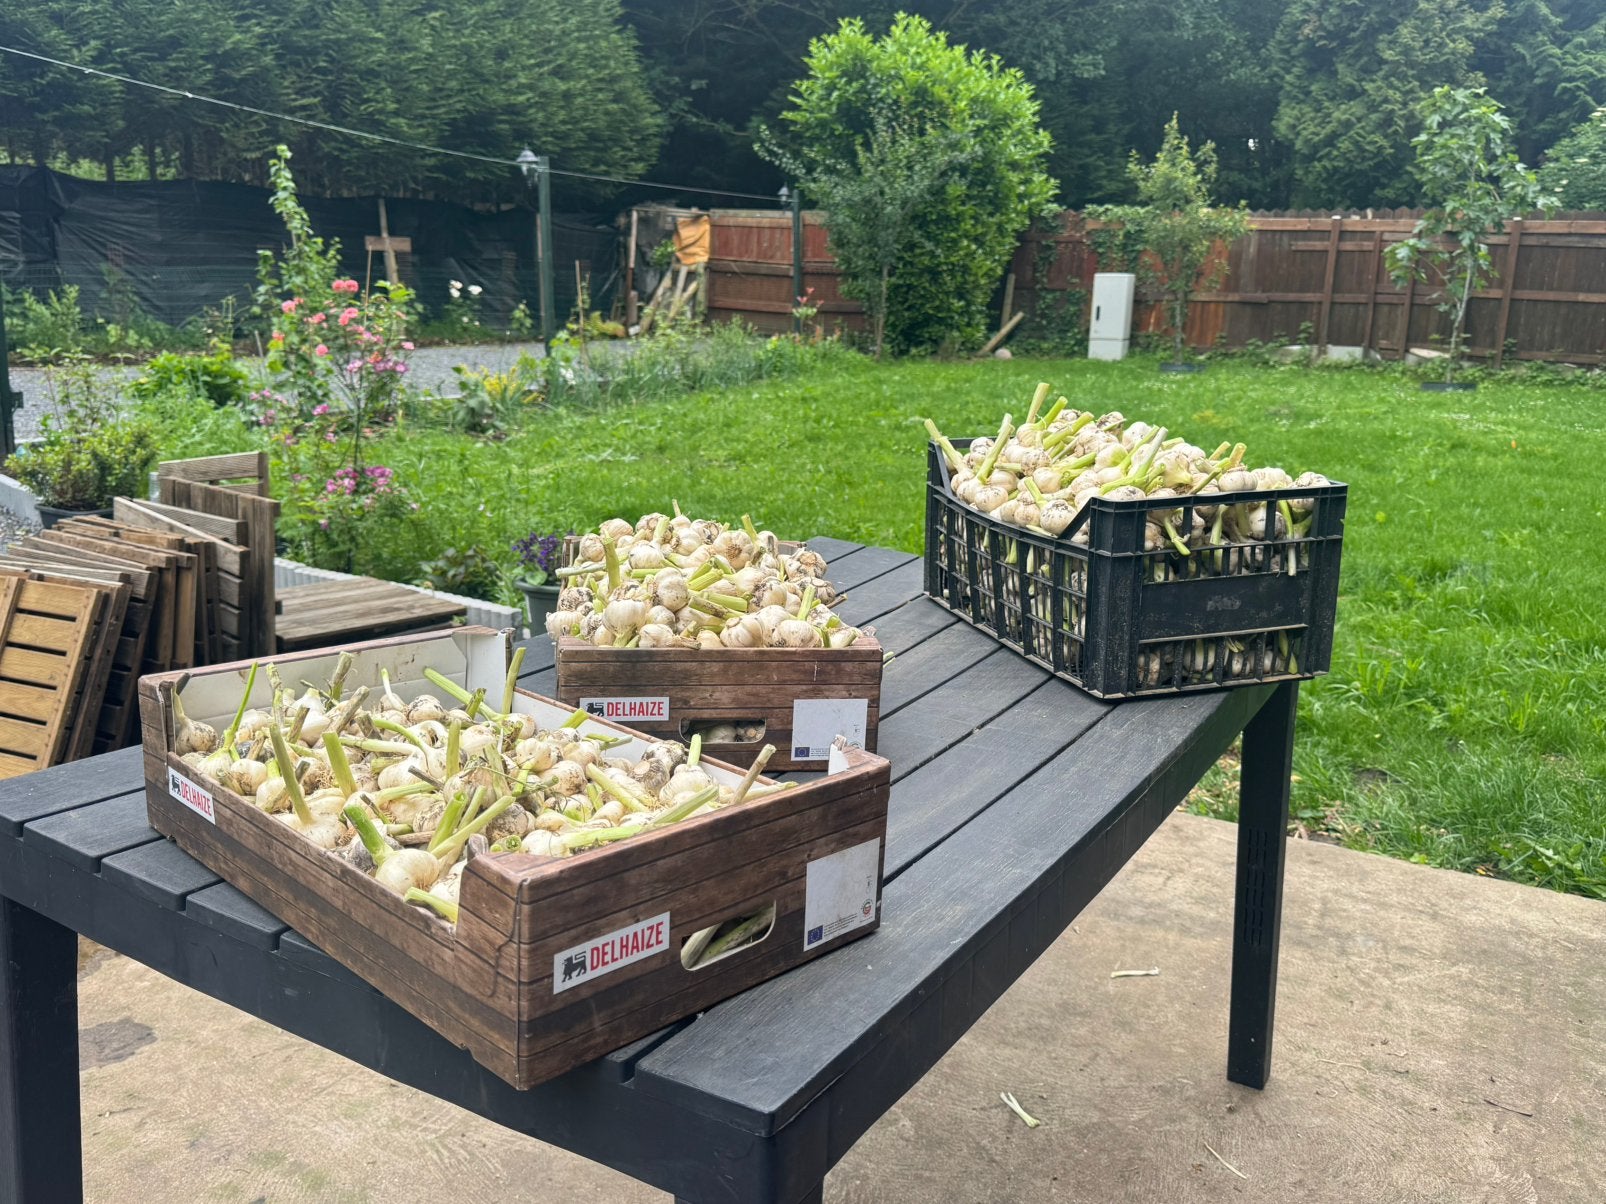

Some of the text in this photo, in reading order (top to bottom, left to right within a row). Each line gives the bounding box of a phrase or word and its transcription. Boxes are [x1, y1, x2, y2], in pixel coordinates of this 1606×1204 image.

[606, 701, 664, 717] DELHAIZE
[180, 780, 212, 817] DELHAIZE
[590, 920, 664, 972] DELHAIZE
